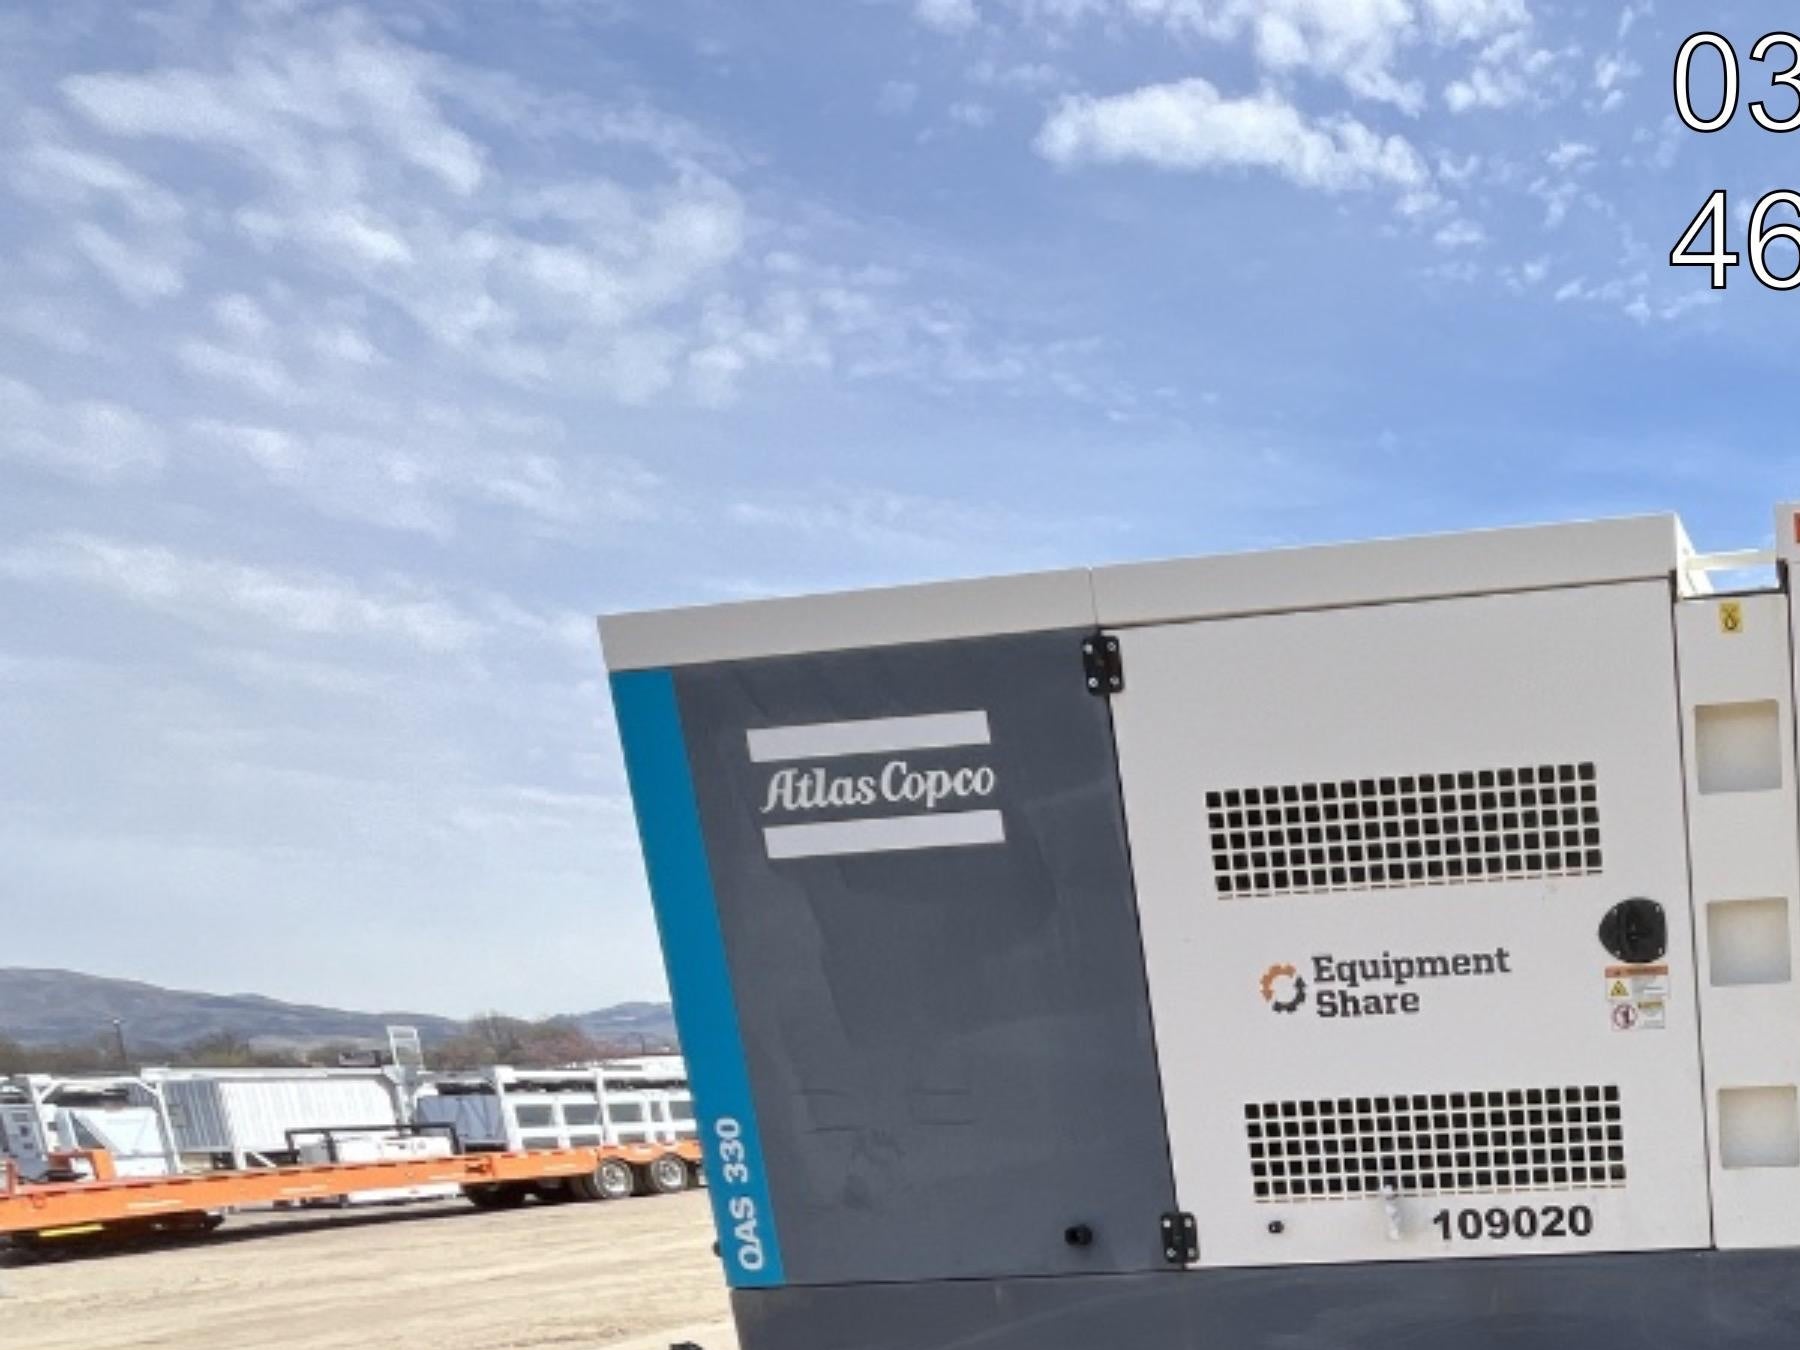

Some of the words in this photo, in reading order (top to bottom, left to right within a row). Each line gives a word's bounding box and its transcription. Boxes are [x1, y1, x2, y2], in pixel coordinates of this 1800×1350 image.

[760, 767, 876, 813] Atlas
[880, 761, 995, 808] Copco
[1311, 948, 1511, 988] Equipment
[1316, 990, 1421, 1017] Share
[714, 1117, 748, 1182] 330
[1433, 1205, 1594, 1240] 109020
